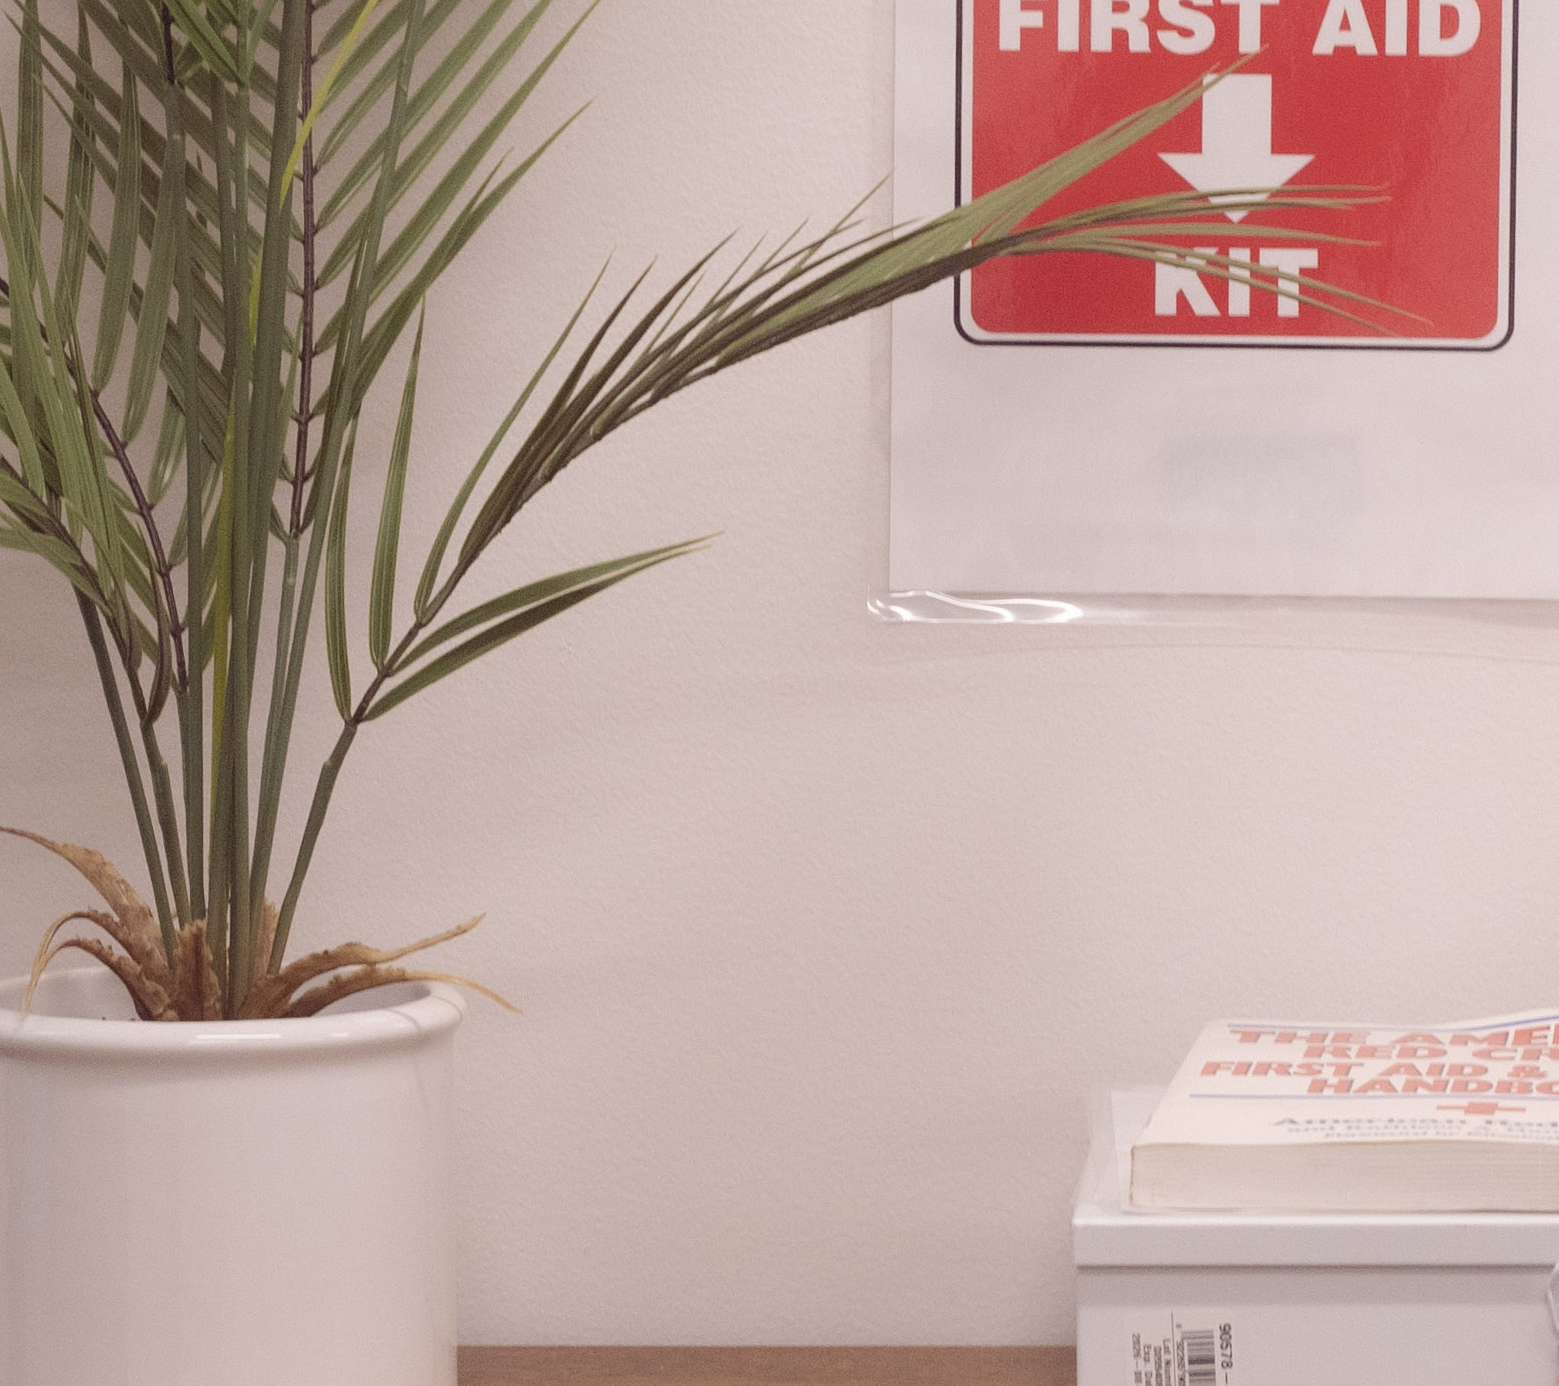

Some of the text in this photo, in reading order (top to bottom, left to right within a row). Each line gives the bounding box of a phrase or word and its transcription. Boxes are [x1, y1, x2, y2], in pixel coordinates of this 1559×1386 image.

[1153, 244, 1320, 318] KIT
[1229, 1029, 1371, 1046] THE
[1302, 1044, 1448, 1060] RED
[1200, 1061, 1365, 1077] FIRST
[1376, 1062, 1490, 1078] AID
